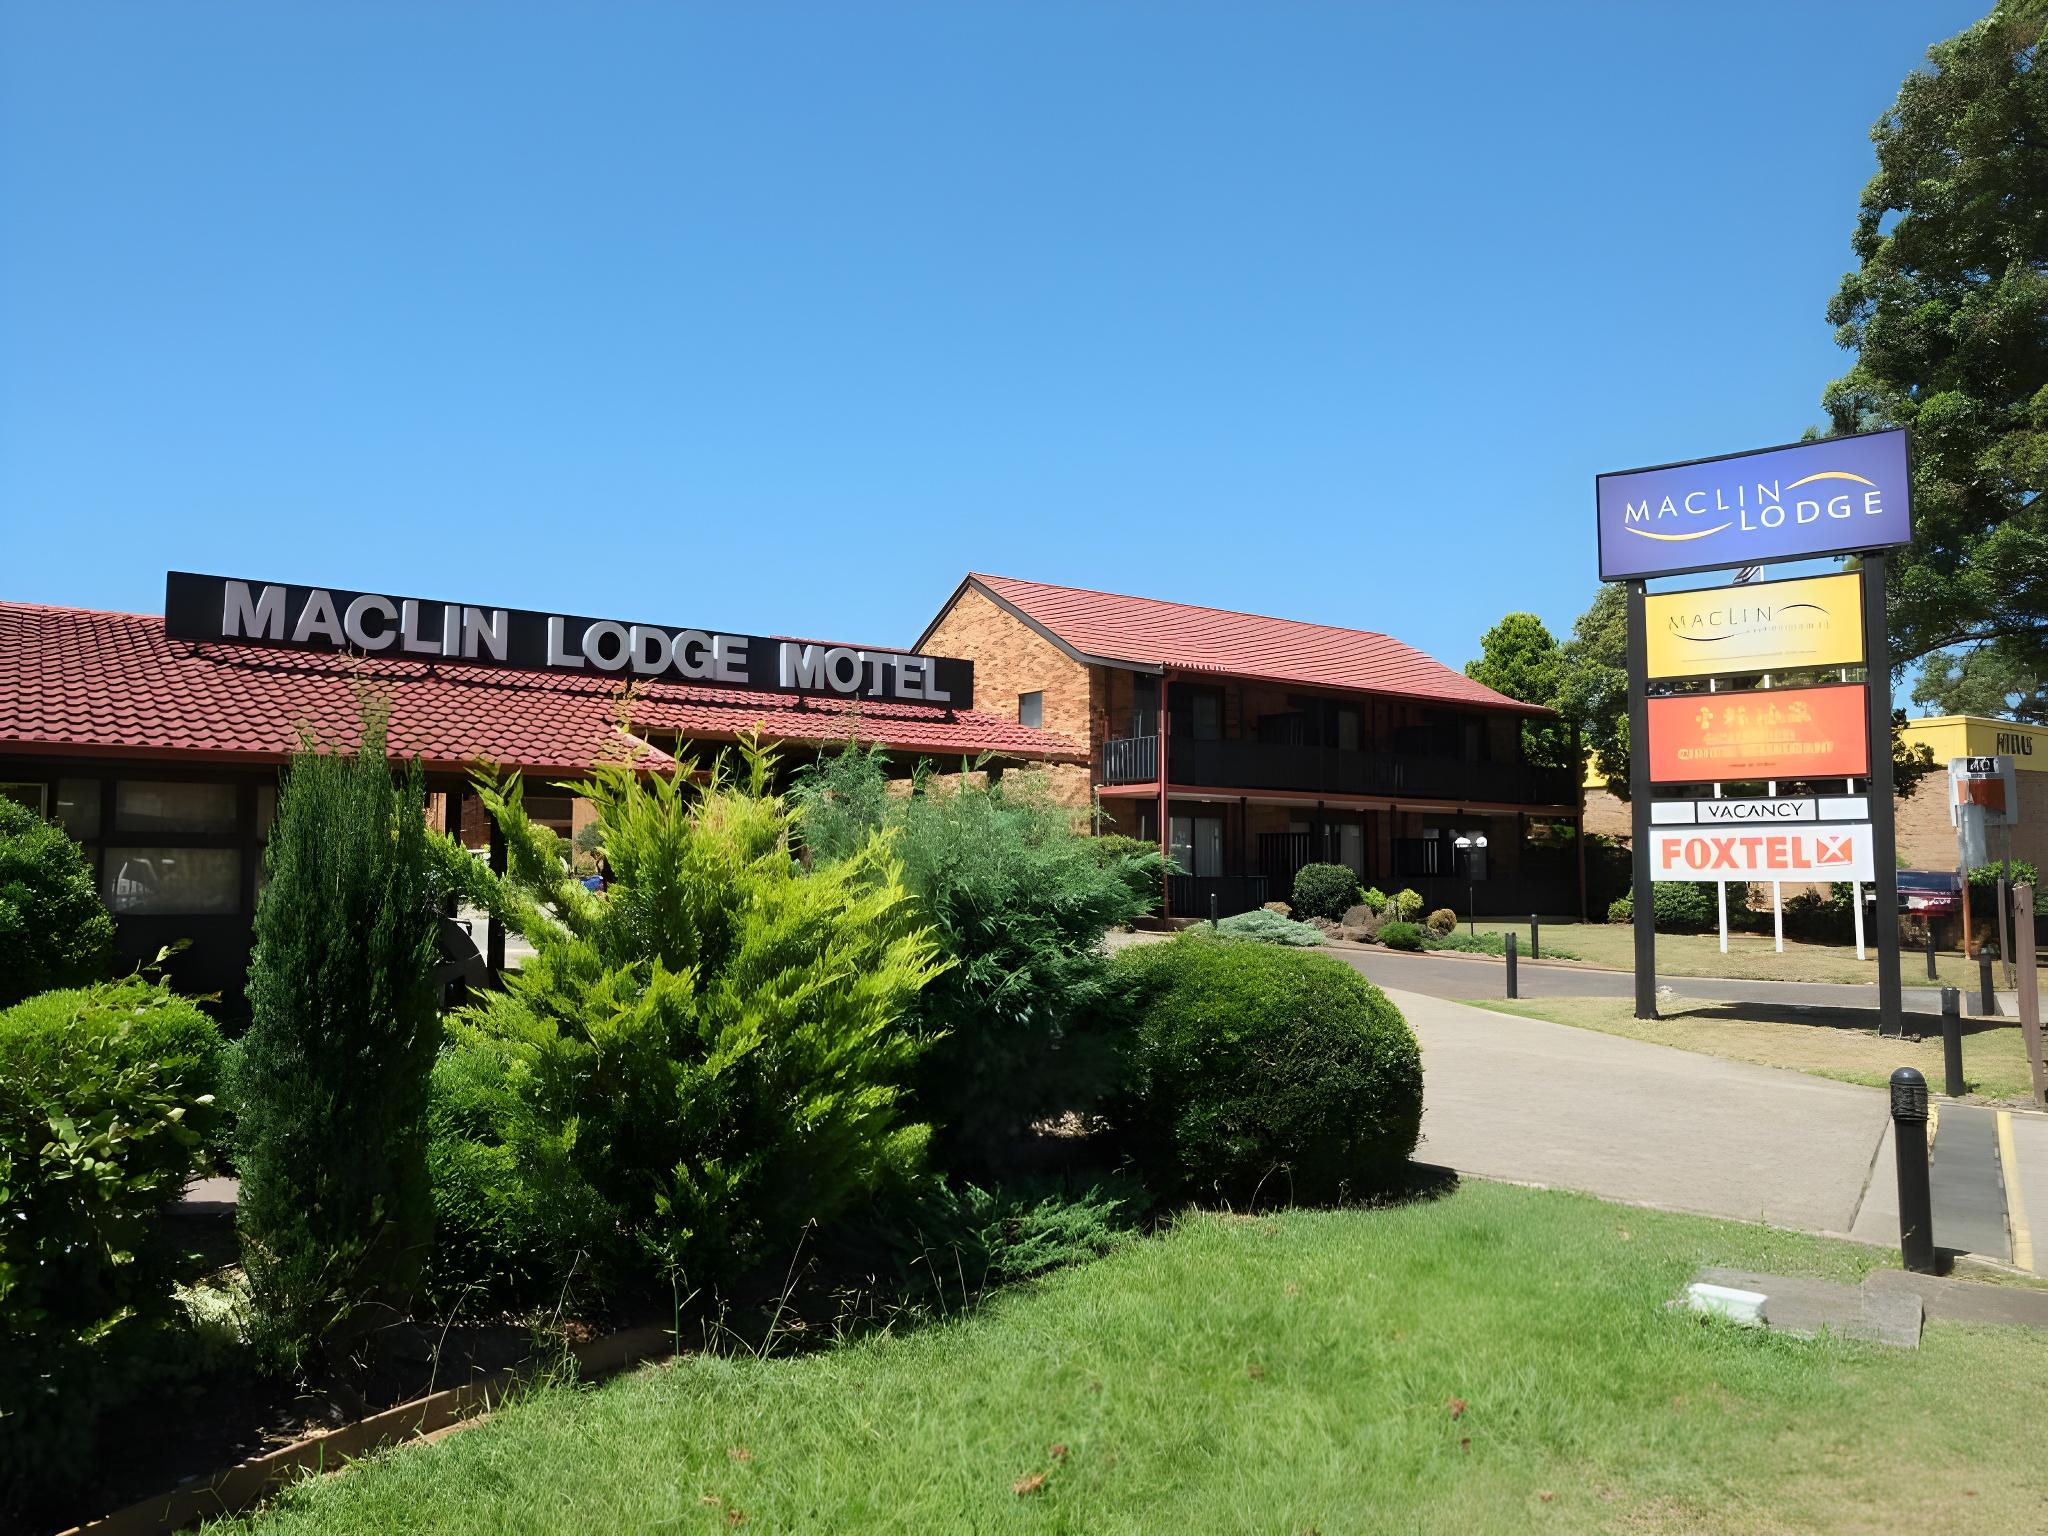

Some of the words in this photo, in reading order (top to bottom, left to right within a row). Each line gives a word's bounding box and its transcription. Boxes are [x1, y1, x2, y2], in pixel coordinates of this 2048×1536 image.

[1624, 479, 1780, 524] MACLIN
[1740, 490, 1883, 531] LODGE
[1669, 606, 1772, 631] MACLIN
[222, 580, 508, 661] MACLIN
[547, 616, 749, 683] LODGE
[779, 642, 951, 701] MOTEL
[1708, 802, 1804, 819] VACANCY
[1662, 836, 1812, 870] FOXTEL
